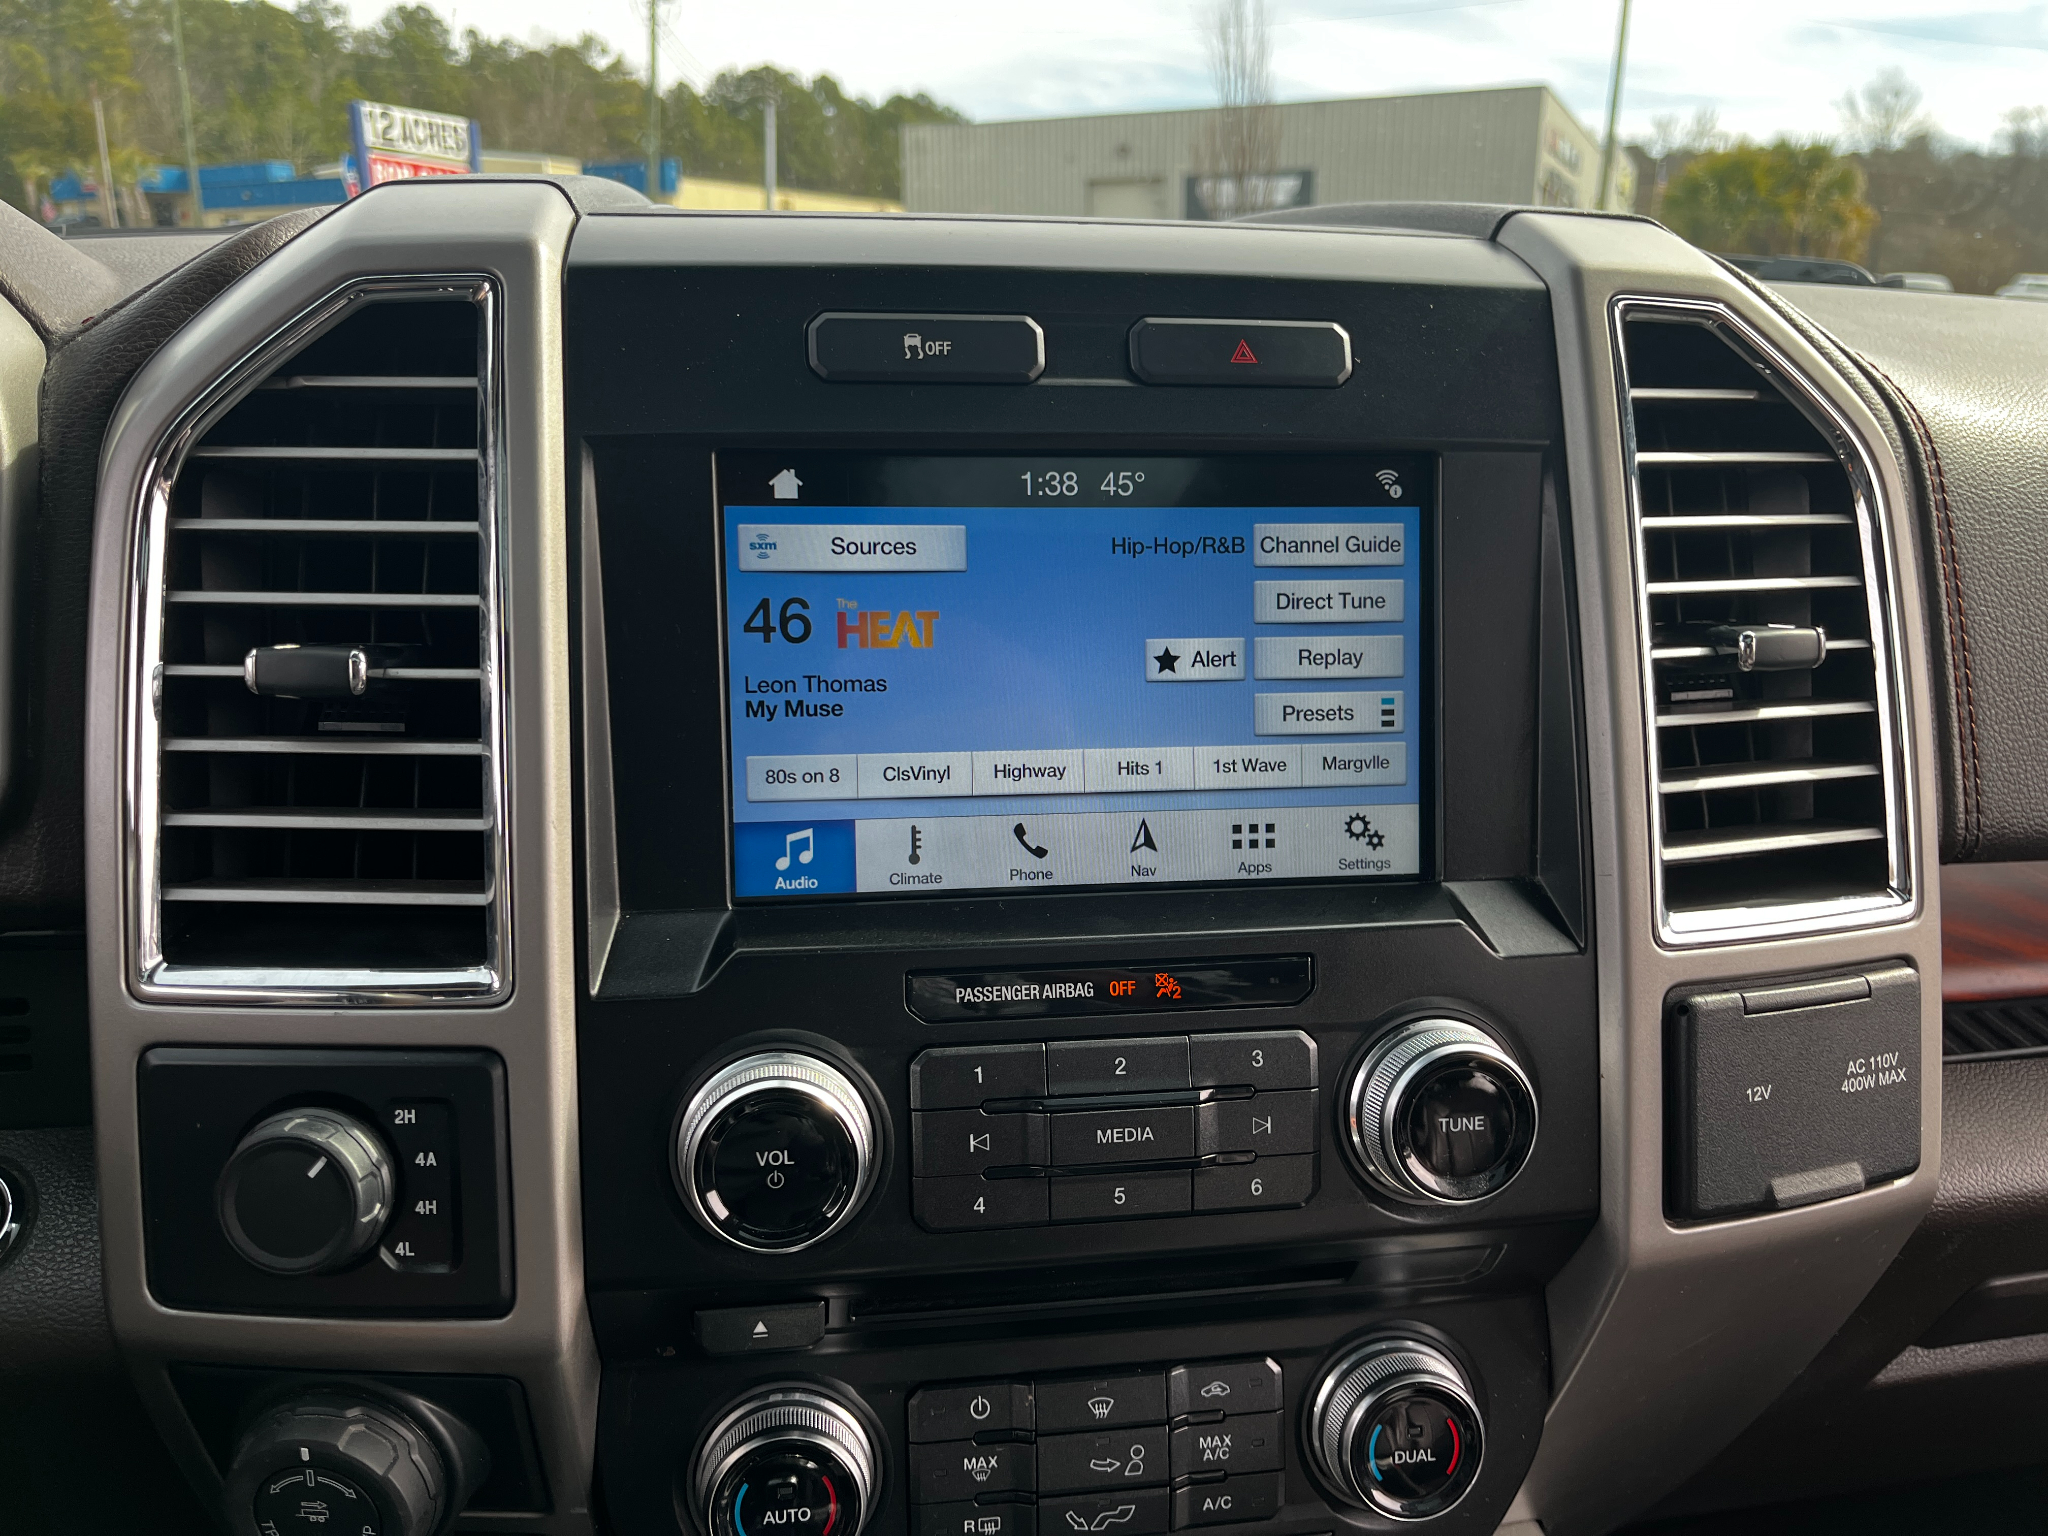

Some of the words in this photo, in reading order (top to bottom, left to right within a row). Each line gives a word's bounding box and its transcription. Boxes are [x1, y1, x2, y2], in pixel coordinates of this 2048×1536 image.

[368, 109, 395, 142] 12
[401, 115, 467, 151] ACRES
[925, 341, 952, 356] OFF
[1020, 471, 1079, 497] 1:38
[749, 541, 778, 552] sxm
[830, 536, 917, 556] Sources
[1110, 536, 1246, 559] Hip-Hop/R&B
[1259, 535, 1340, 554] Channel
[1344, 535, 1402, 554] Guide
[836, 598, 858, 610] The
[1275, 592, 1333, 610] Direct
[1337, 591, 1387, 610] Tune
[742, 596, 813, 644] 46
[836, 610, 940, 649] HEAT
[1190, 650, 1237, 668] Alert
[1298, 648, 1364, 669] Replay
[744, 676, 797, 695] Leon
[802, 674, 888, 693] Thomas
[744, 700, 778, 722] My
[784, 699, 845, 718] Muse
[1282, 704, 1355, 722] Presets
[993, 762, 1067, 782] Highway
[1117, 760, 1150, 776] Hits
[1155, 760, 1164, 775] 1
[1212, 759, 1238, 774] 1st
[1241, 758, 1288, 773] Wave
[1321, 754, 1391, 774] Margvlle
[765, 769, 798, 785] 80s
[802, 772, 825, 784] on
[828, 768, 841, 784] 8
[882, 765, 952, 784] ClsVinyl
[1130, 864, 1157, 878] Nav
[1237, 861, 1273, 876] Apps
[1338, 857, 1391, 872] Settings
[774, 875, 819, 890] Audio
[889, 871, 943, 886] Climate
[1009, 868, 1054, 882] Phone
[955, 985, 1040, 1003] PASSENGER
[1043, 982, 1095, 999] AIRBAG
[1109, 980, 1137, 997] OFF
[1113, 1056, 1127, 1075] 2
[1250, 1049, 1264, 1068] 3
[1847, 1058, 1866, 1075] AC
[1868, 1052, 1899, 1070] 110V
[973, 1065, 984, 1084] 1
[1841, 1074, 1876, 1093] 400W
[1879, 1068, 1907, 1086] MAX
[1746, 1084, 1772, 1103] 12V
[394, 1109, 417, 1125] 2H
[1438, 1115, 1486, 1133] TUNE
[1095, 1126, 1155, 1144] MEDIA
[415, 1151, 438, 1167] 4A
[755, 1149, 795, 1167] VOL
[1113, 1187, 1126, 1205] 5
[1250, 1178, 1263, 1196] 6
[415, 1200, 437, 1215] 4H
[972, 1197, 986, 1214] 4
[395, 1241, 415, 1257] 4L
[1199, 1433, 1233, 1450] MAX
[963, 1455, 999, 1471] MAX
[1202, 1446, 1231, 1462] A/C
[1393, 1447, 1437, 1465] DUAL
[1202, 1495, 1233, 1511] A/C
[762, 1507, 812, 1526] AUTO
[964, 1519, 975, 1533] R
